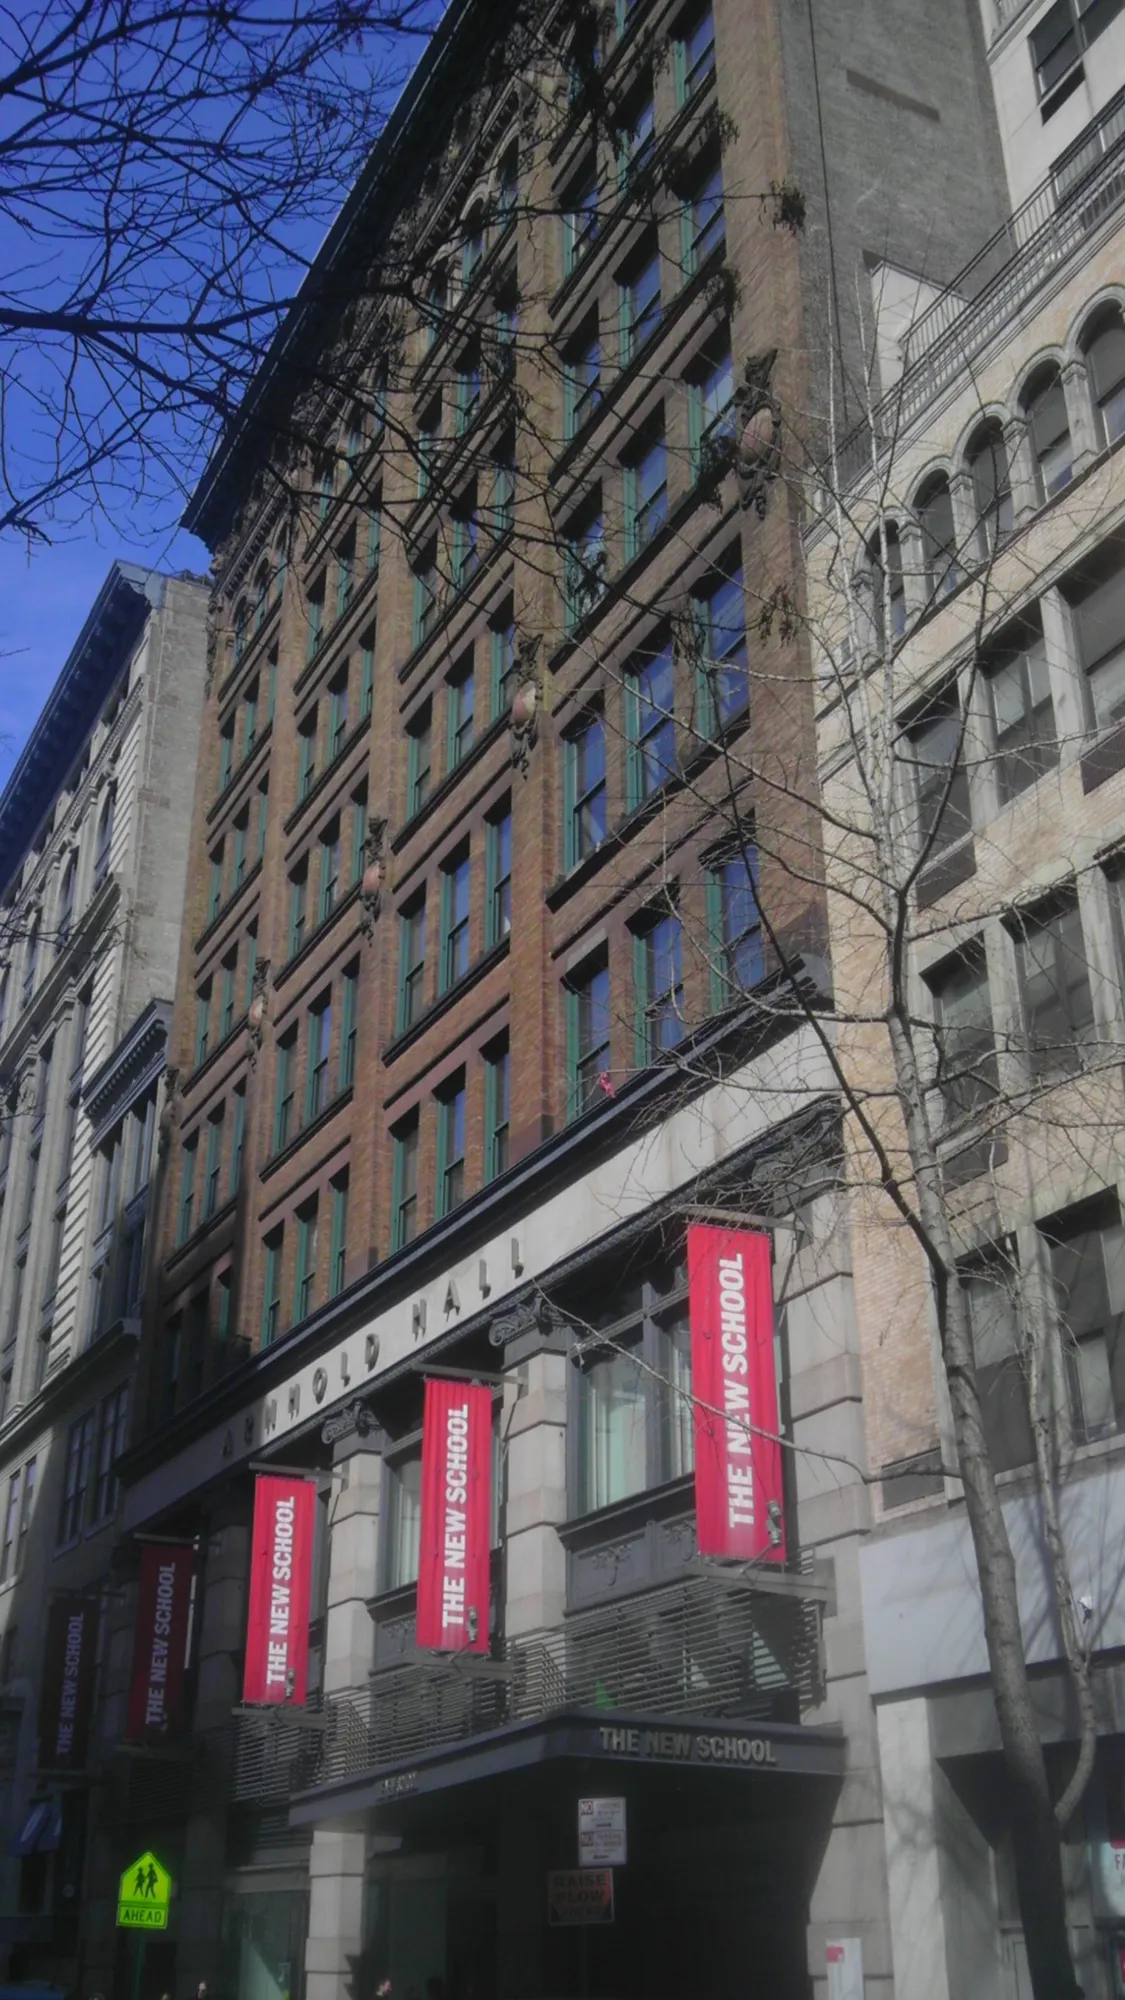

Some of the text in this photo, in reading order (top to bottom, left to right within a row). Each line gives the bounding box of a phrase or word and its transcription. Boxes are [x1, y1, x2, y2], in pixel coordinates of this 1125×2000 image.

[222, 1238, 524, 1458] ARNHOLD HALL
[718, 1252, 755, 1528] THE NEW SCHOOL
[266, 1496, 295, 1685] THE NEW SCHOOL
[442, 1403, 469, 1628] THE NEW SCHOOL
[56, 1612, 84, 1756] THE NEW SCHOOL
[144, 1562, 176, 1725] THE NEW SCHOOL
[600, 1726, 777, 1763] THE NEW SCHOOL
[123, 1909, 162, 1923] AHEAD
[553, 1873, 607, 1888] RAISE
